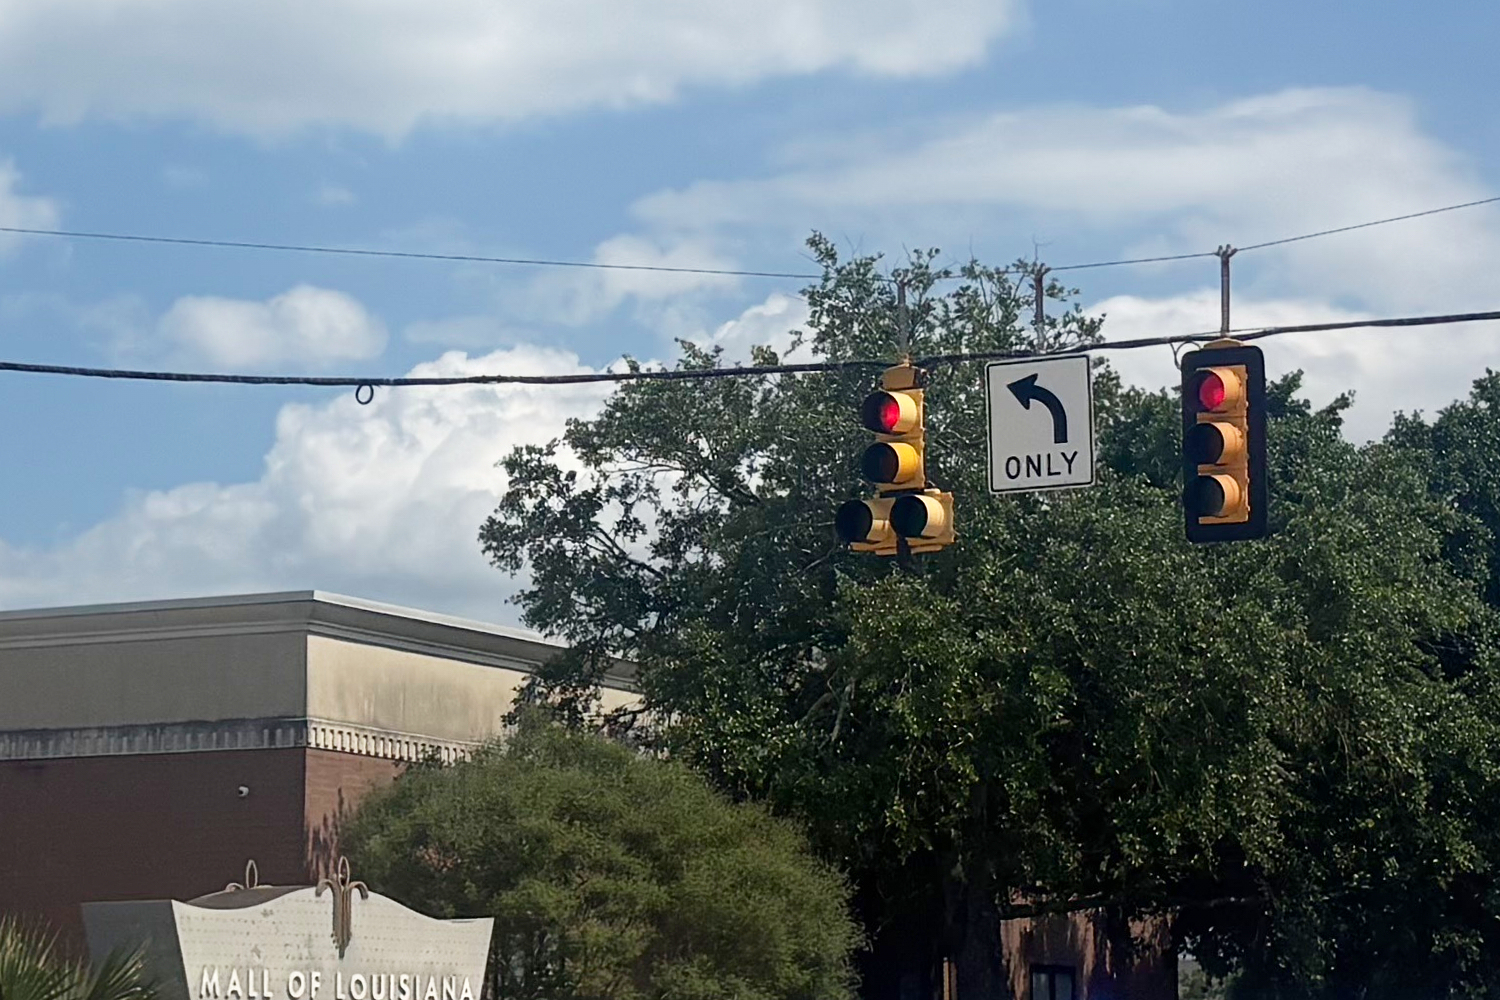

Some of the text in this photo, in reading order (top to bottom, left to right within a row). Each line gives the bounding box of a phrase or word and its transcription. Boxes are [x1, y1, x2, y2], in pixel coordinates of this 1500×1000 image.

[1005, 450, 1078, 480] ONLY
[200, 967, 273, 1000] MALL
[288, 970, 321, 1000] OF
